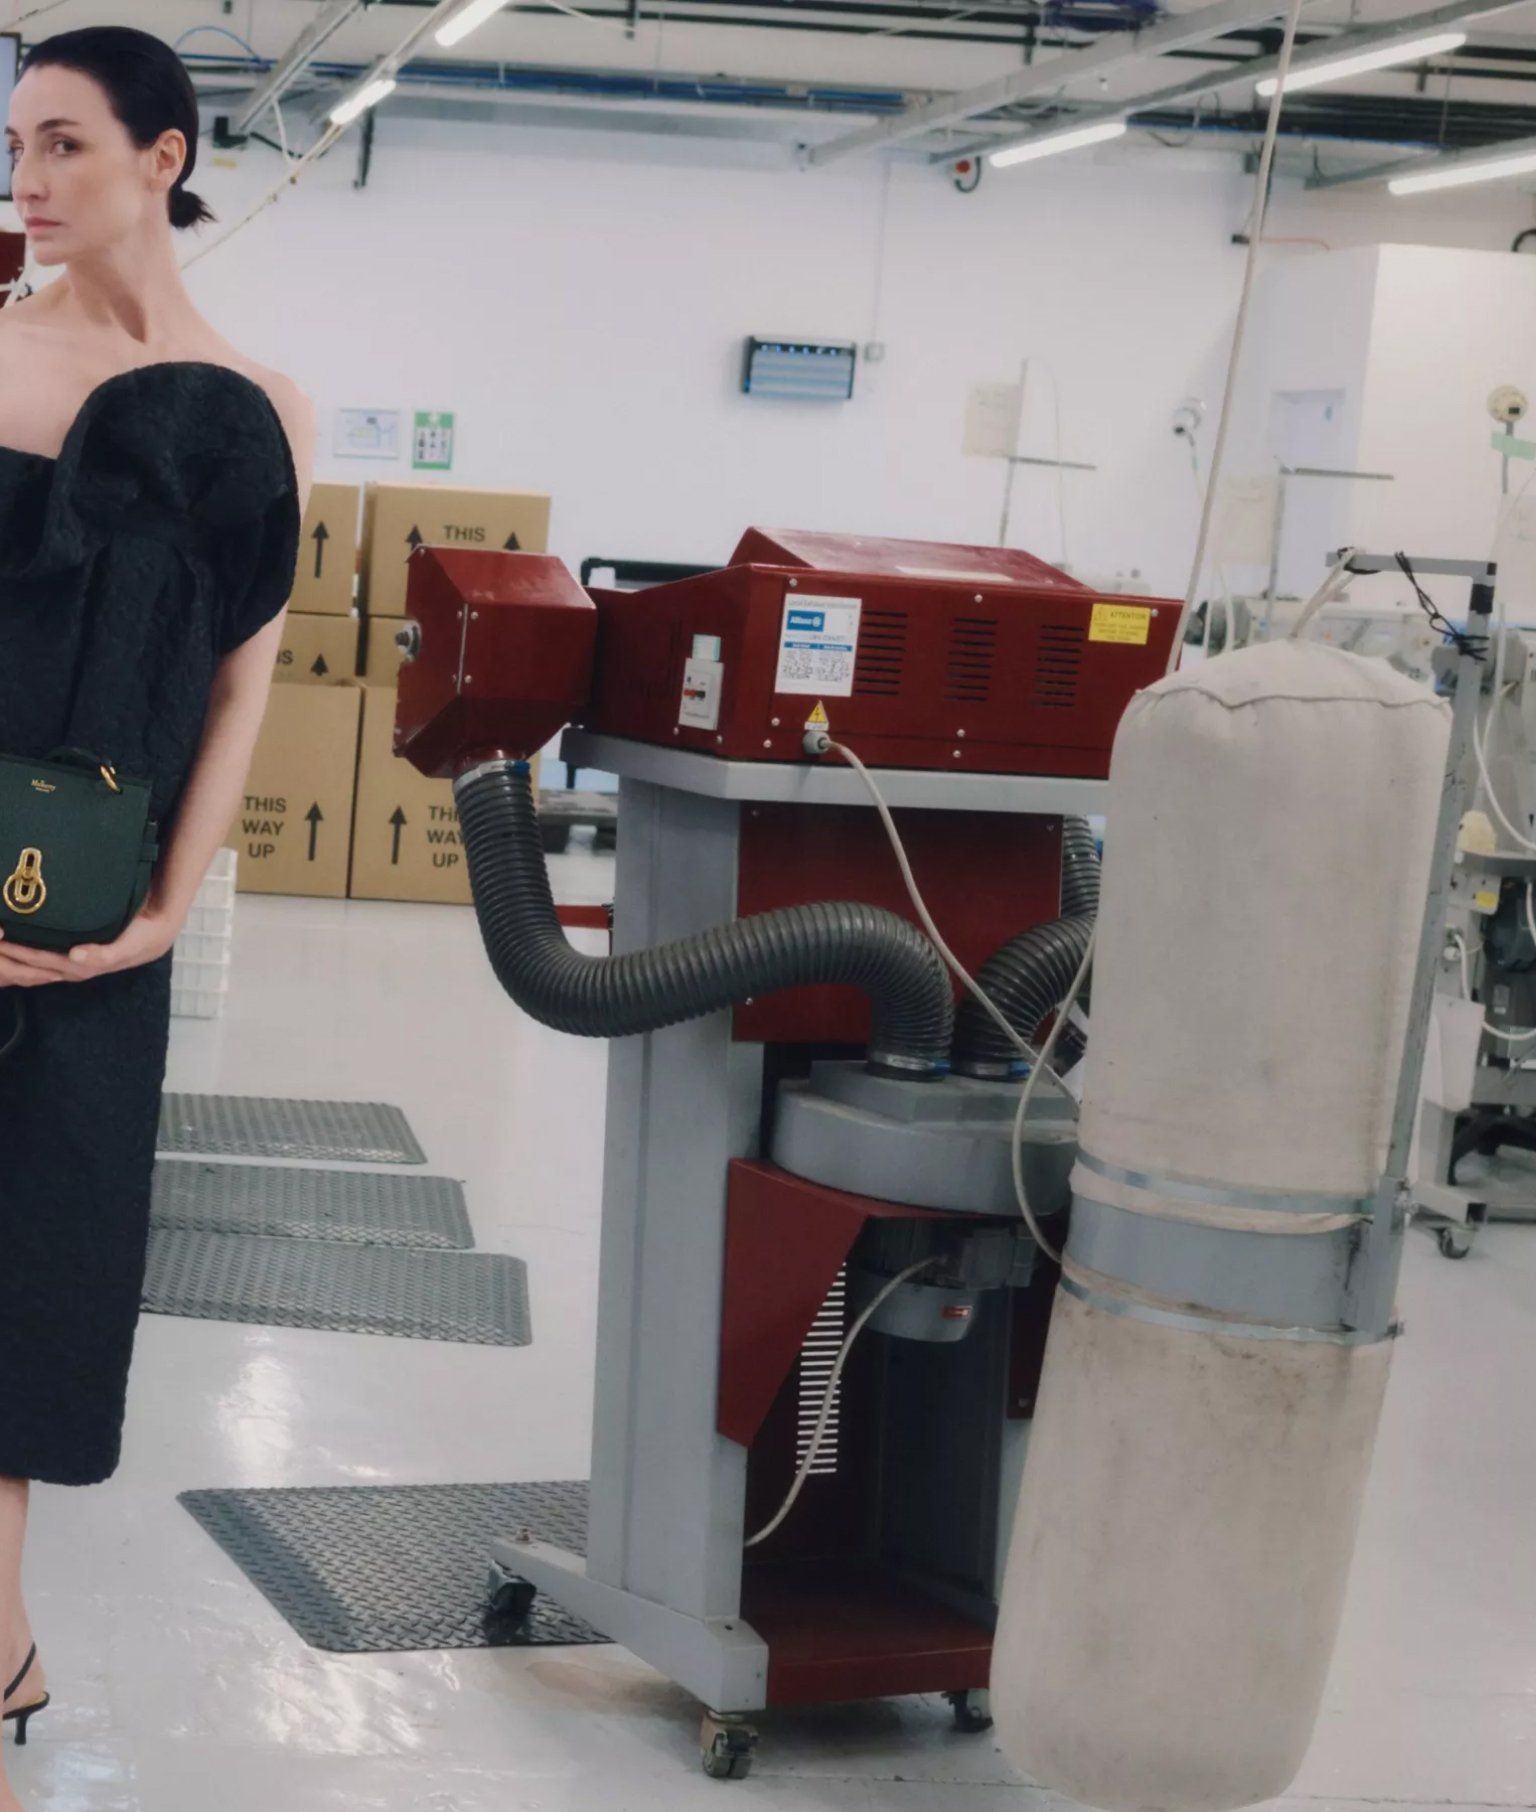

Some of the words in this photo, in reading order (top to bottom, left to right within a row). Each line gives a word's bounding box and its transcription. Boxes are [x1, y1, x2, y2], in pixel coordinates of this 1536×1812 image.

[444, 525, 486, 542] THIS
[244, 796, 287, 813] THIS
[428, 805, 460, 822] THI
[242, 820, 285, 836] WAY
[248, 844, 276, 859] UP
[432, 853, 459, 868] UP
